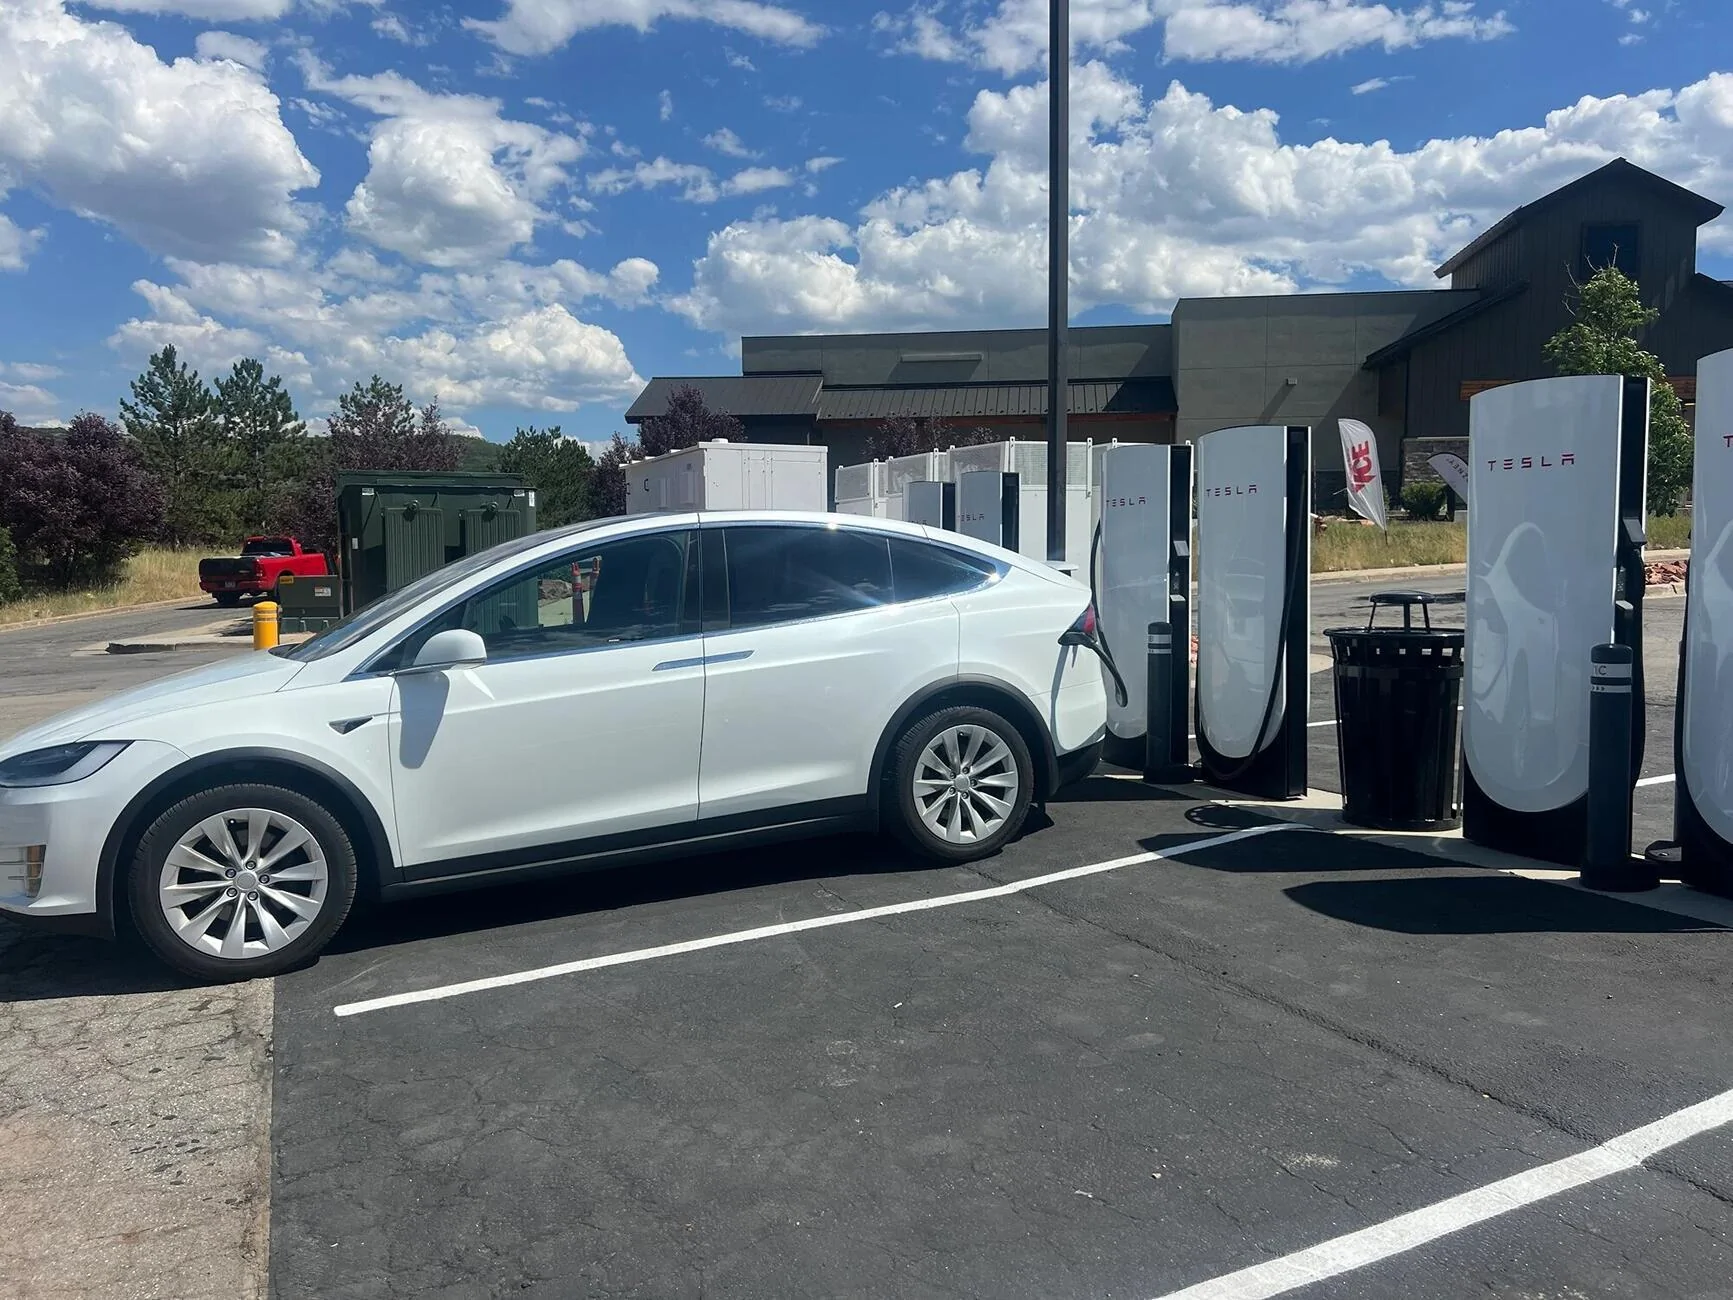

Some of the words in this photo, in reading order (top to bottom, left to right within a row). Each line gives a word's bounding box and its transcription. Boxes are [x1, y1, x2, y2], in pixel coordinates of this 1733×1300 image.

[1351, 440, 1377, 493] ACE
[1487, 453, 1575, 472] TESLA
[1206, 484, 1257, 498] TESLA
[1106, 496, 1146, 508] TESLA
